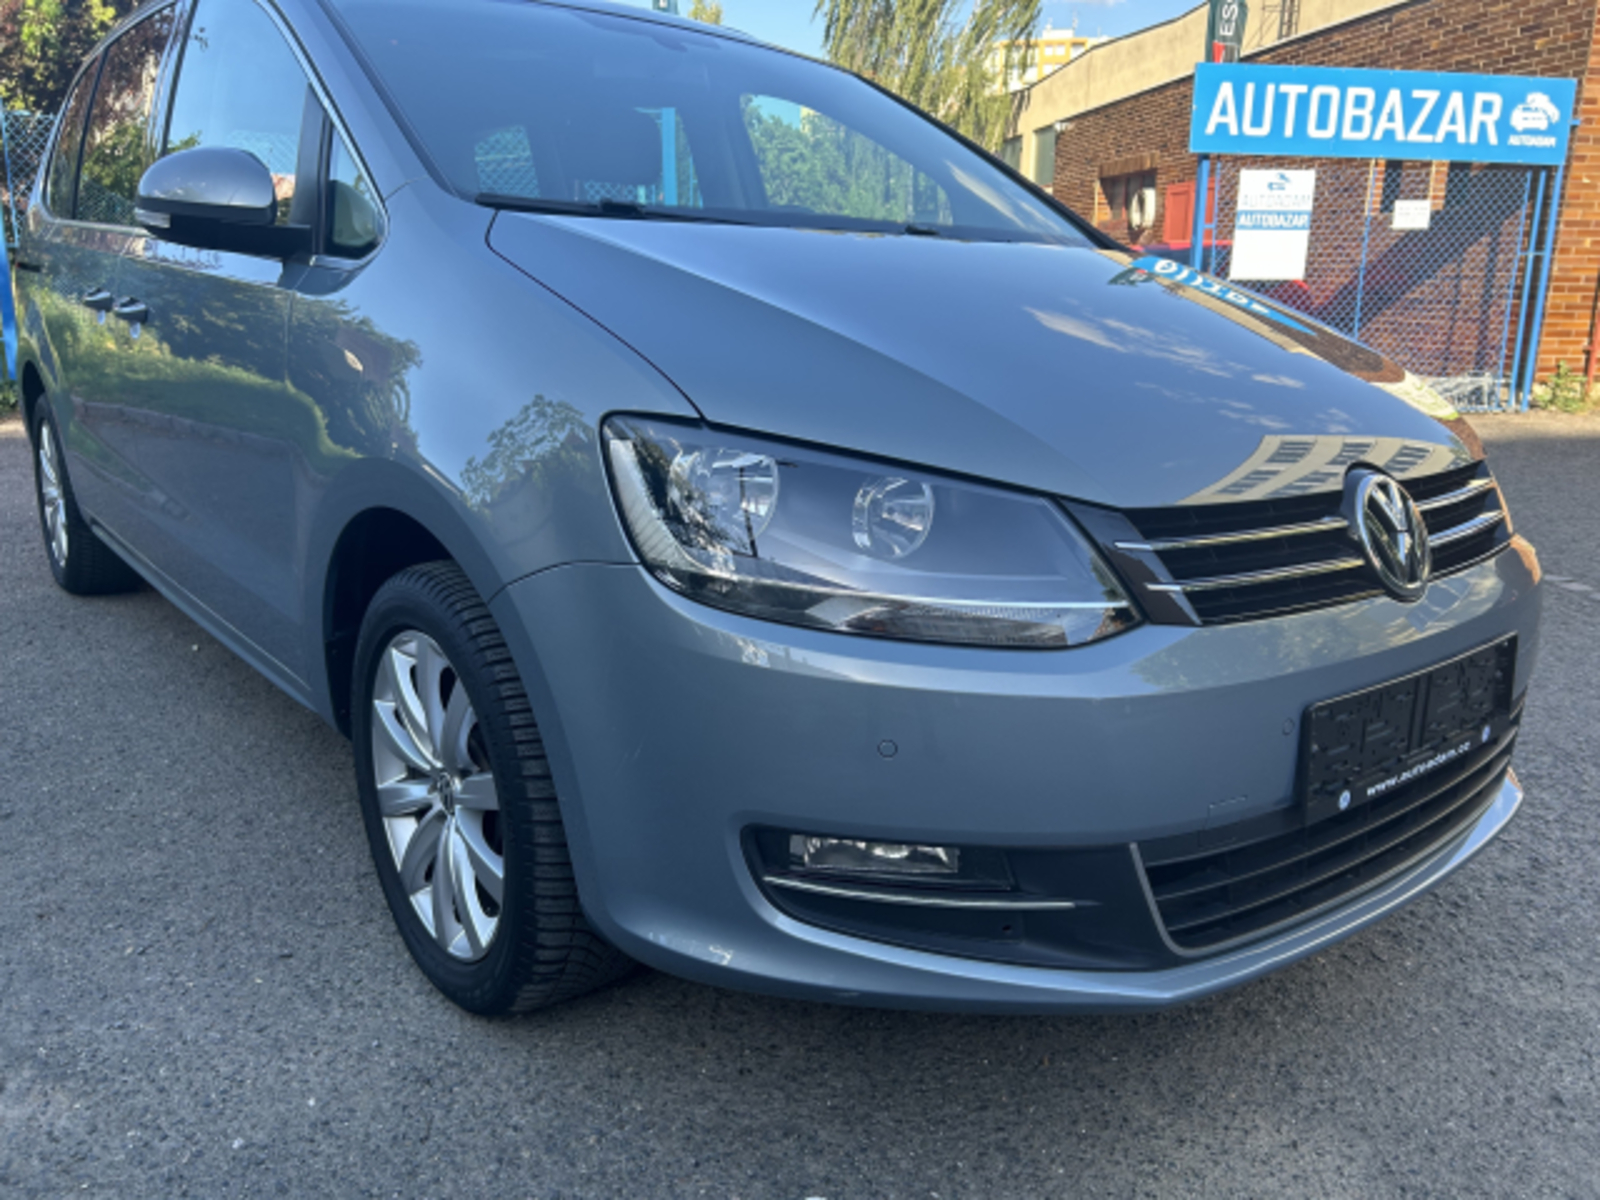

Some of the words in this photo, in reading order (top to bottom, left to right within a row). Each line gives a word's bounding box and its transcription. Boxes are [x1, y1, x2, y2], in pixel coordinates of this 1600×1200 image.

[1219, 0, 1239, 36] ES
[1204, 81, 1503, 146] AUTOBAZAR
[1238, 213, 1309, 228] AUTOBAZAR
